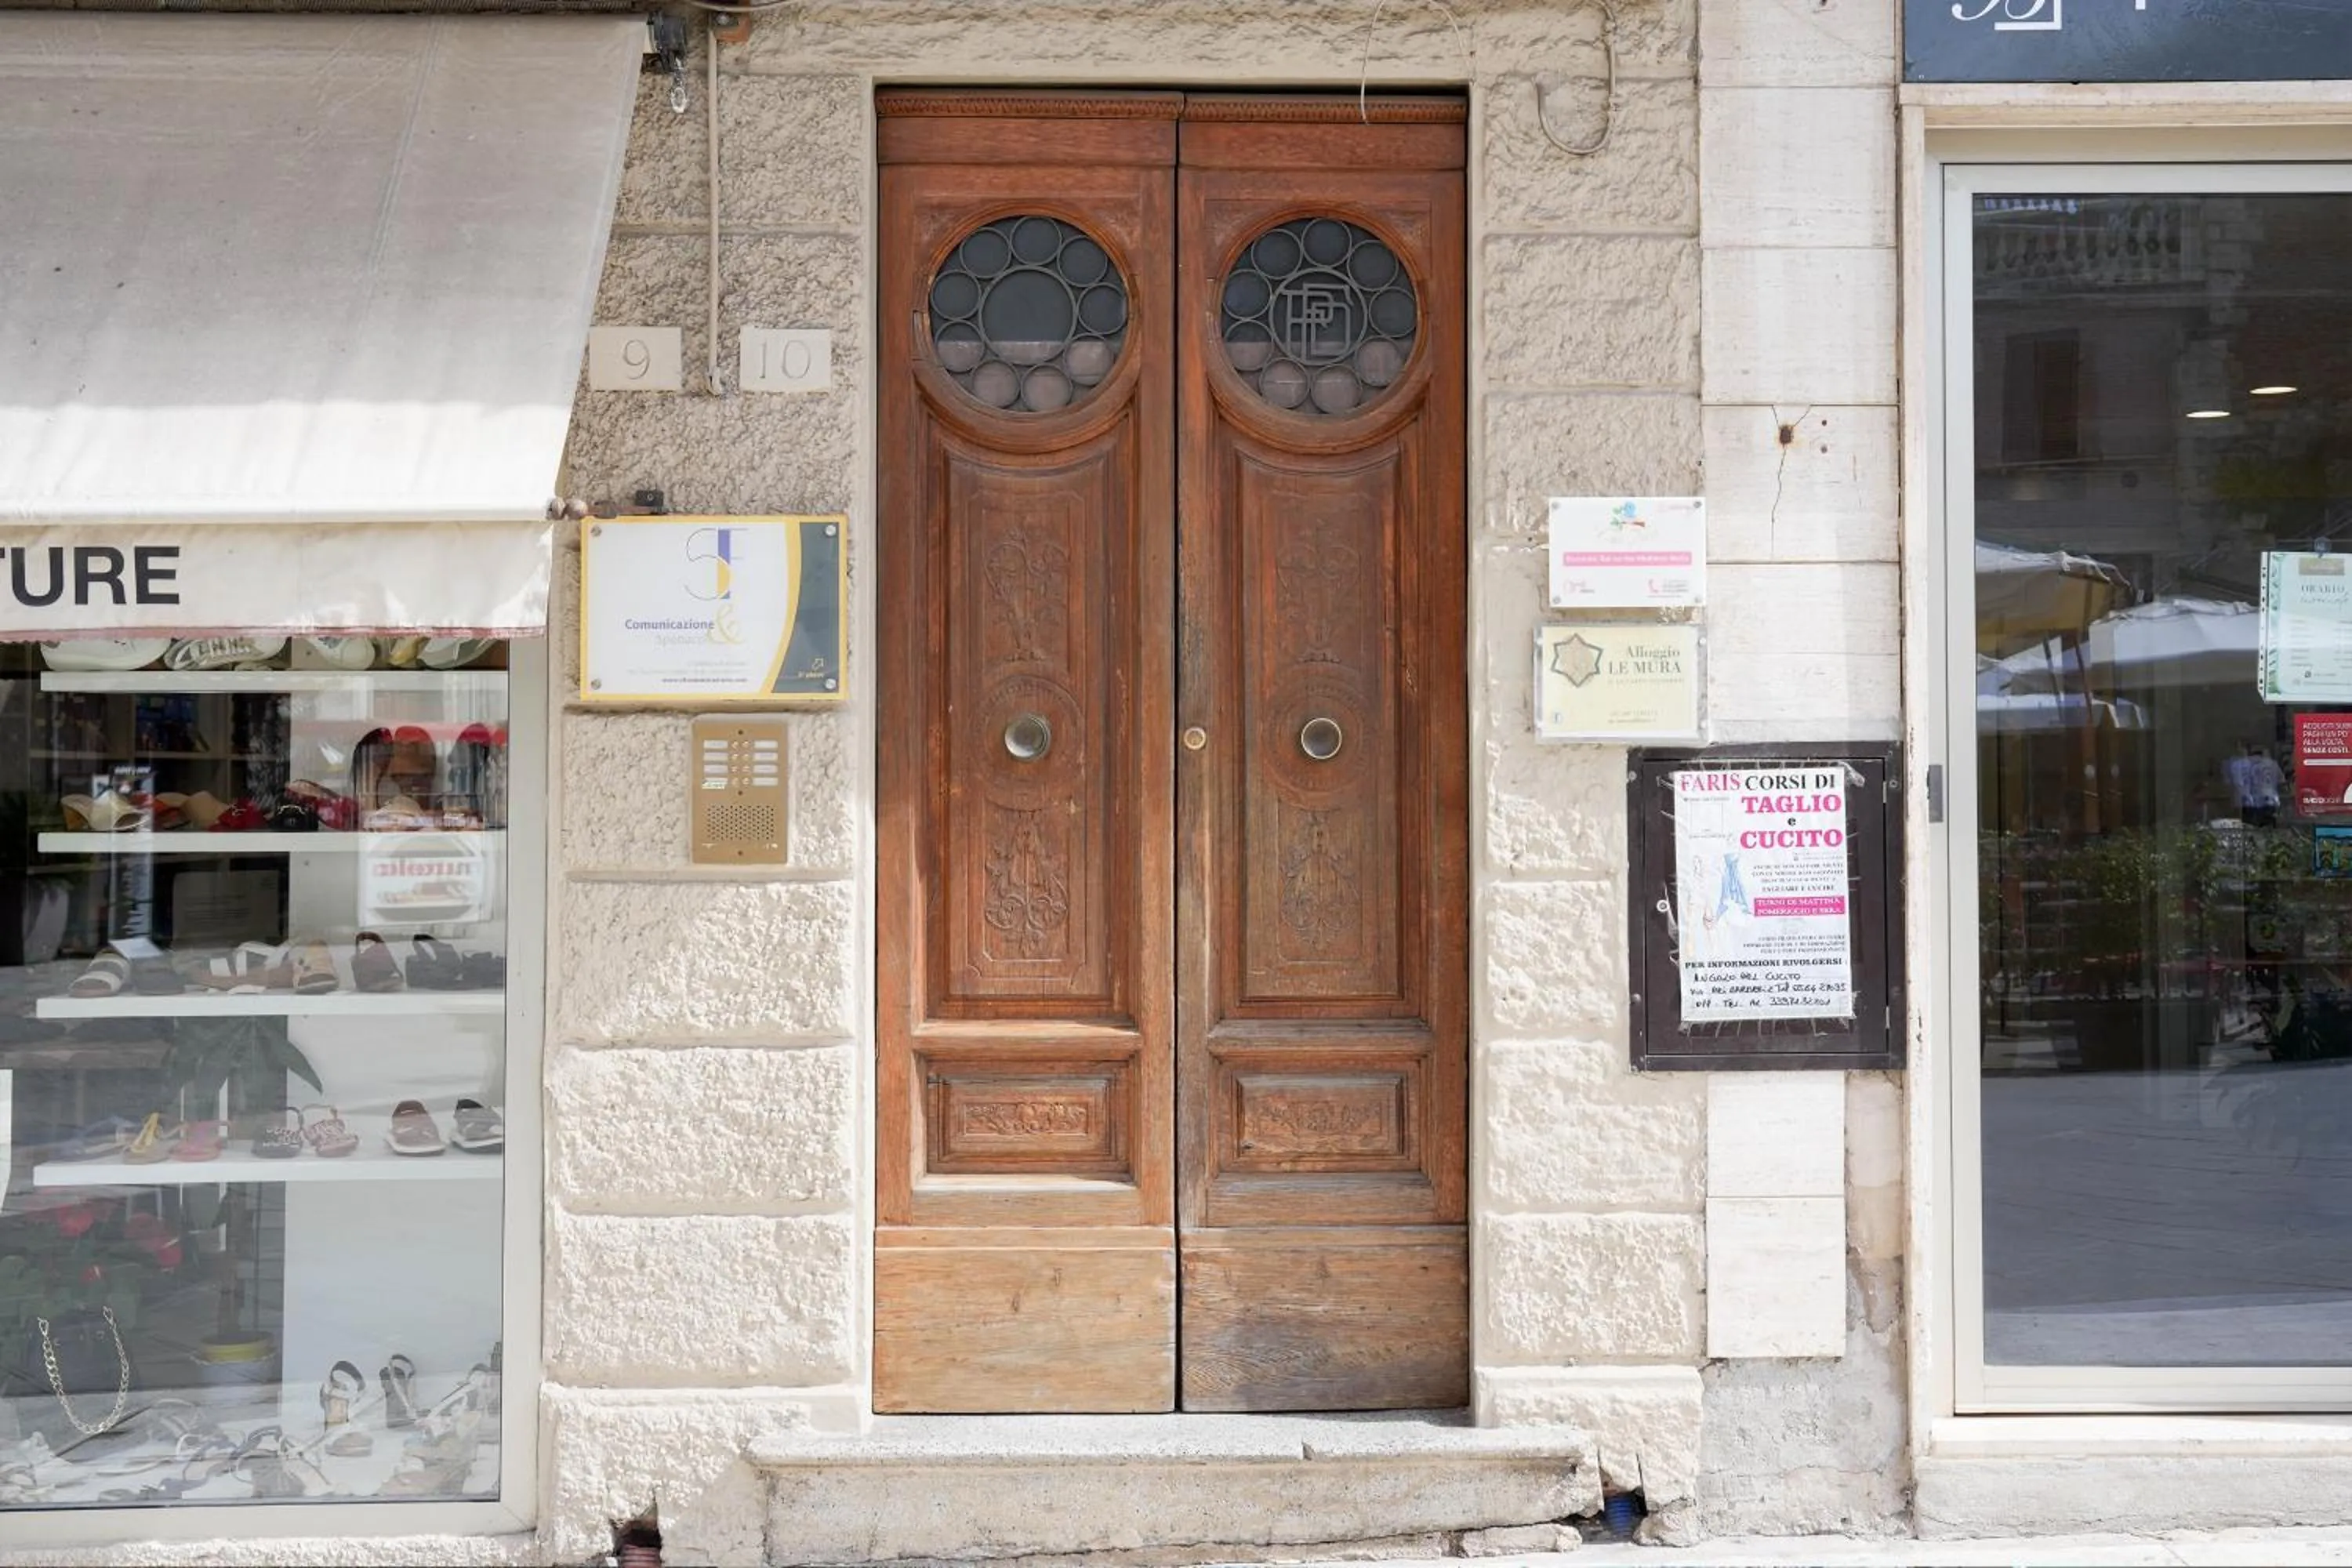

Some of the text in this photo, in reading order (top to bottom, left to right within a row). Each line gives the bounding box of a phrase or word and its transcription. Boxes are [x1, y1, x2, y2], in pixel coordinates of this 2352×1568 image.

[622, 339, 650, 379] 9
[759, 339, 811, 379] 10
[0, 546, 180, 607] URE
[625, 618, 714, 630] Comunicazione
[1633, 661, 1681, 674] MURA
[1681, 774, 1835, 792] FARIS CORSI DI
[1741, 794, 1842, 814] TAGLIO
[1788, 817, 1796, 826] e
[1740, 829, 1842, 849] CUCITO
[1708, 960, 1780, 968] INFORMAZIONI
